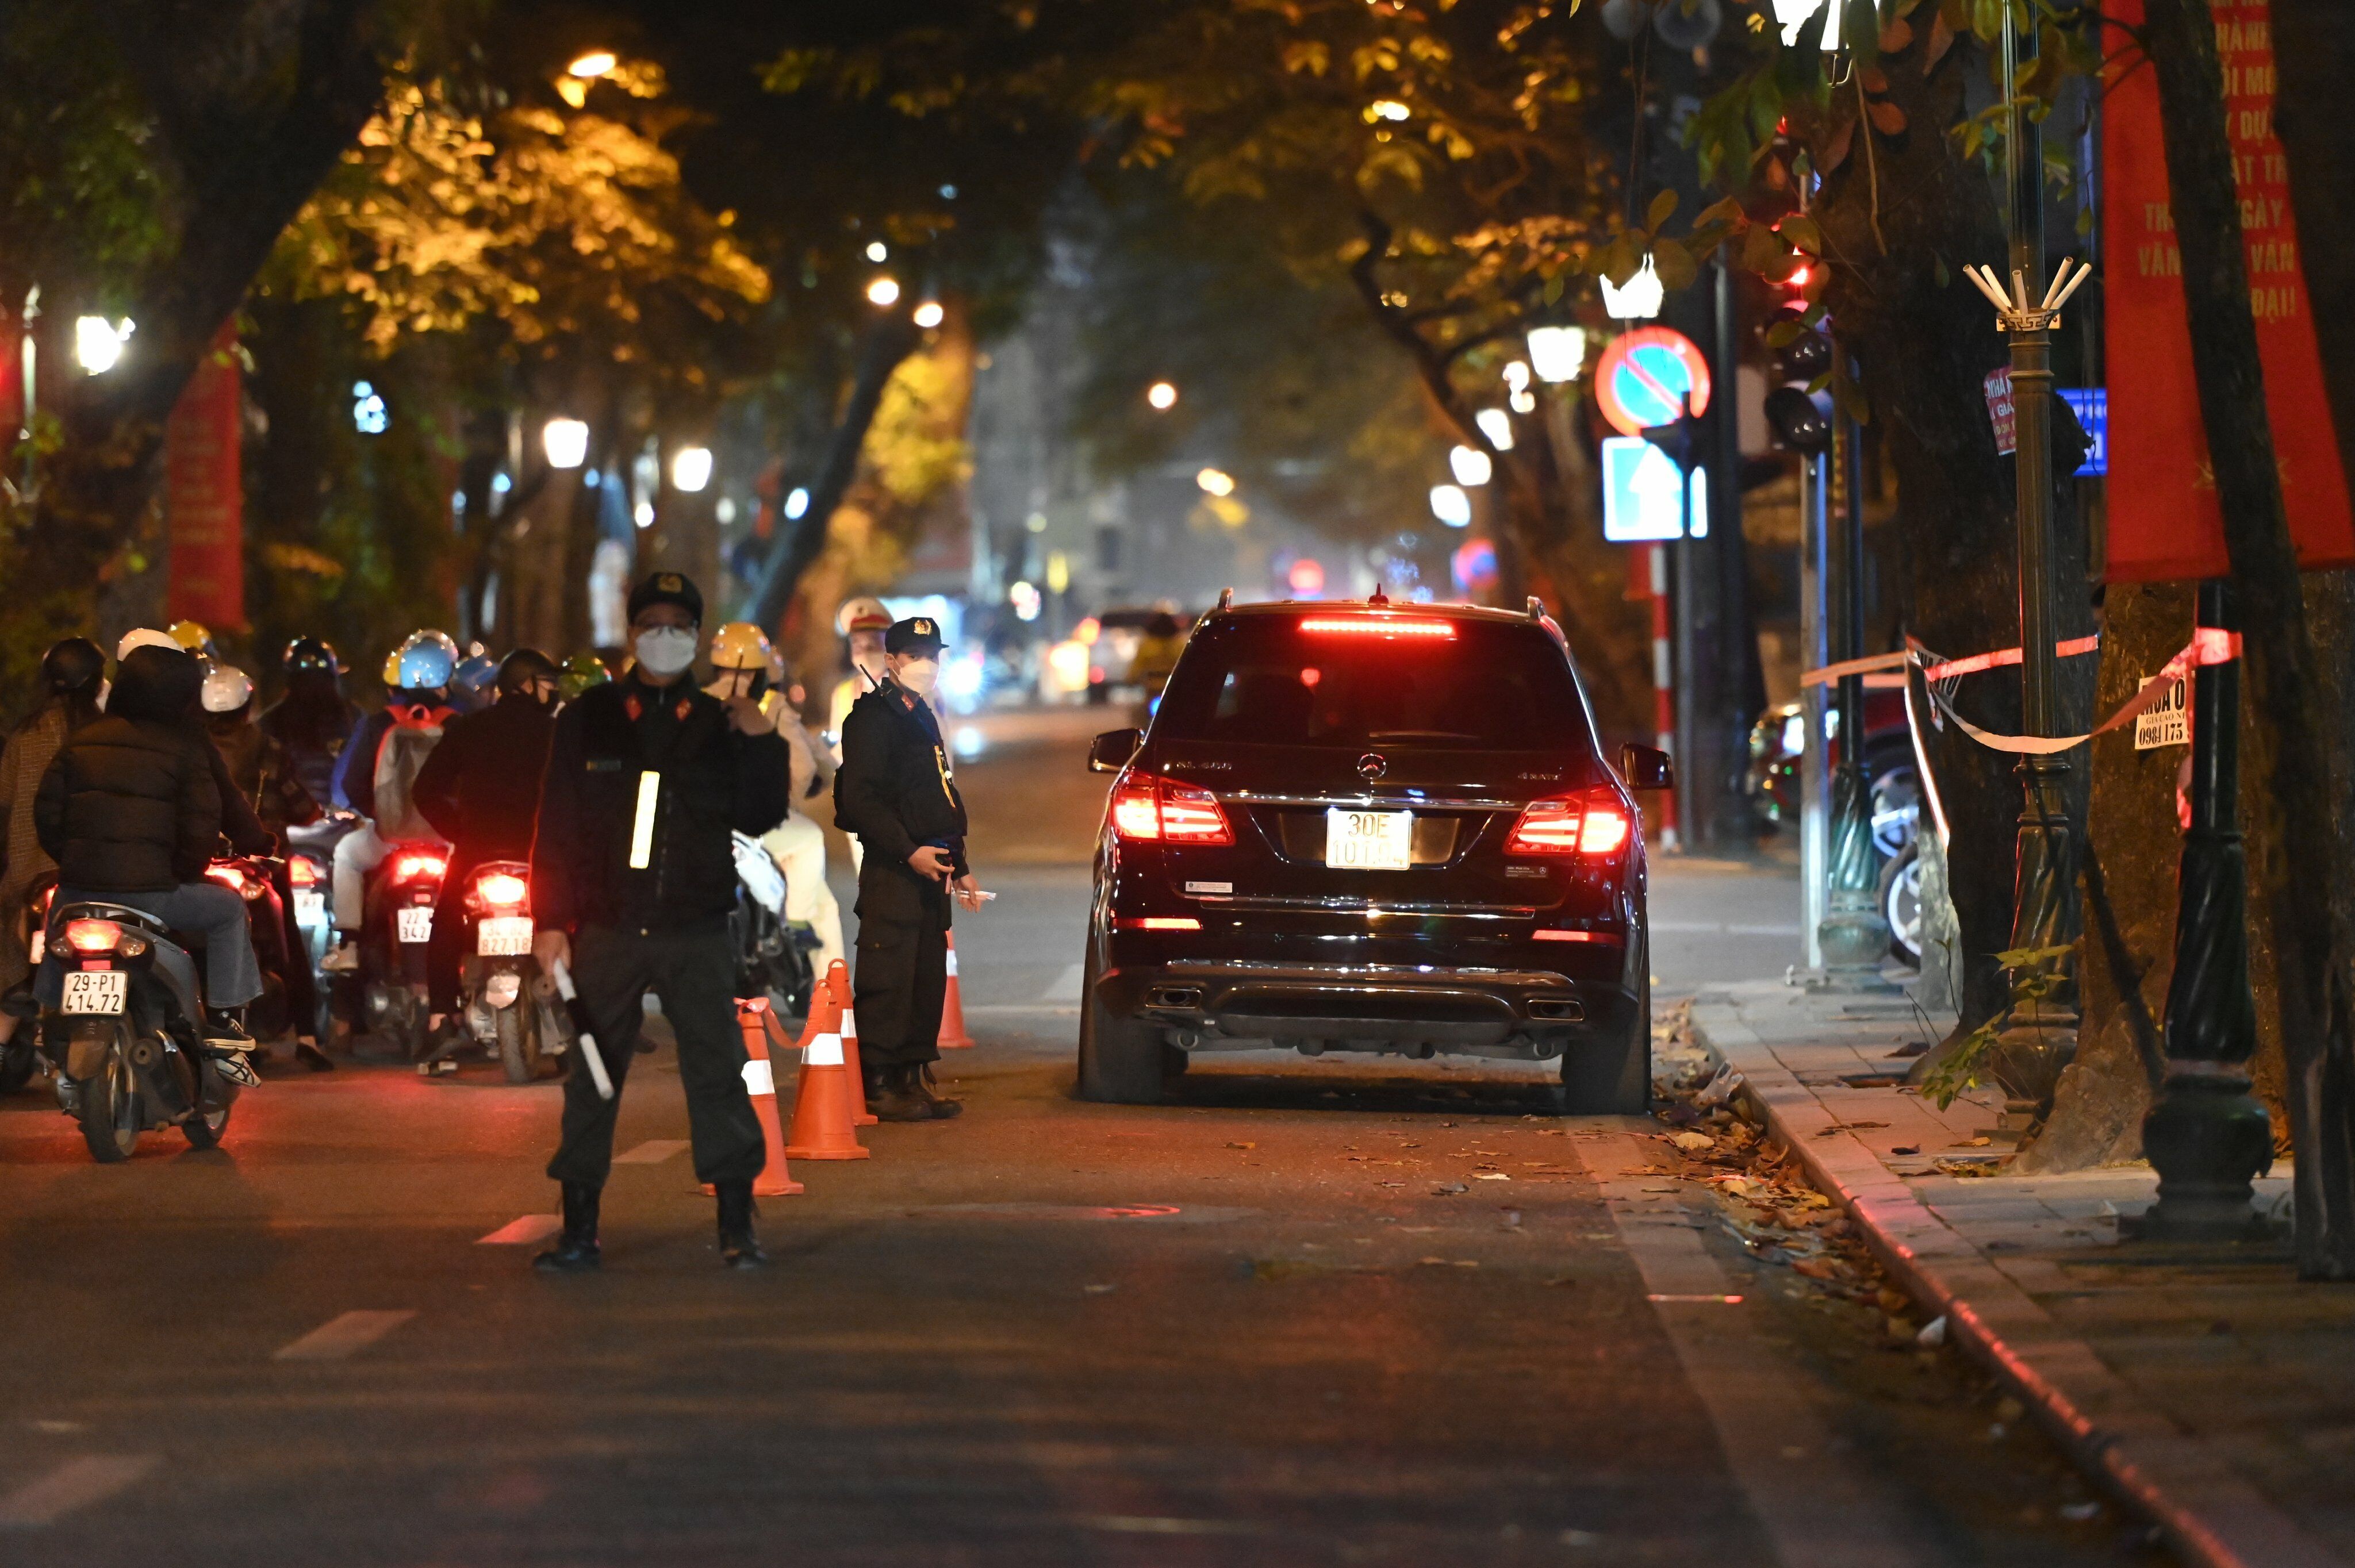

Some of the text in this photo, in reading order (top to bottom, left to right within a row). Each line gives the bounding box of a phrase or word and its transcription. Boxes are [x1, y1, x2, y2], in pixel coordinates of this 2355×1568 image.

[1348, 814, 1390, 837] 30E
[72, 974, 116, 992] 29-P1
[66, 994, 120, 1012] 414.72
